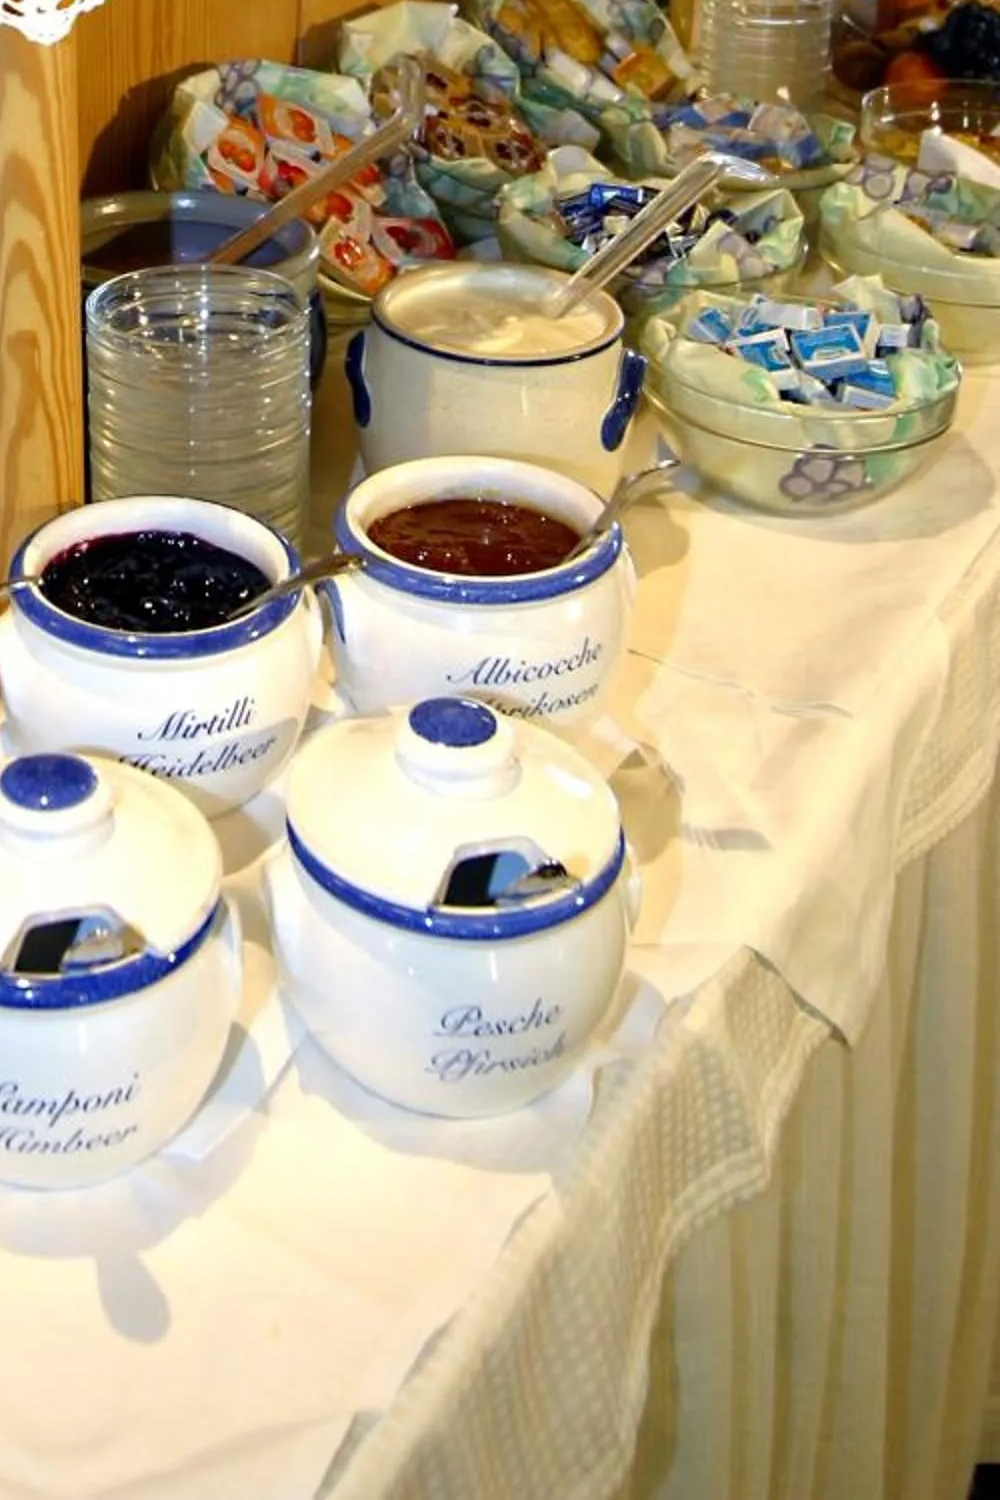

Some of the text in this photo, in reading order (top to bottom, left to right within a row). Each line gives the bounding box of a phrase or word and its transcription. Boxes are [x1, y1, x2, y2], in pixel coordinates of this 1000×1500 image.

[446, 635, 602, 686] Albicocche
[137, 696, 256, 741] Mirtilli
[484, 683, 599, 718] rikosen
[433, 997, 562, 1037] Pesche
